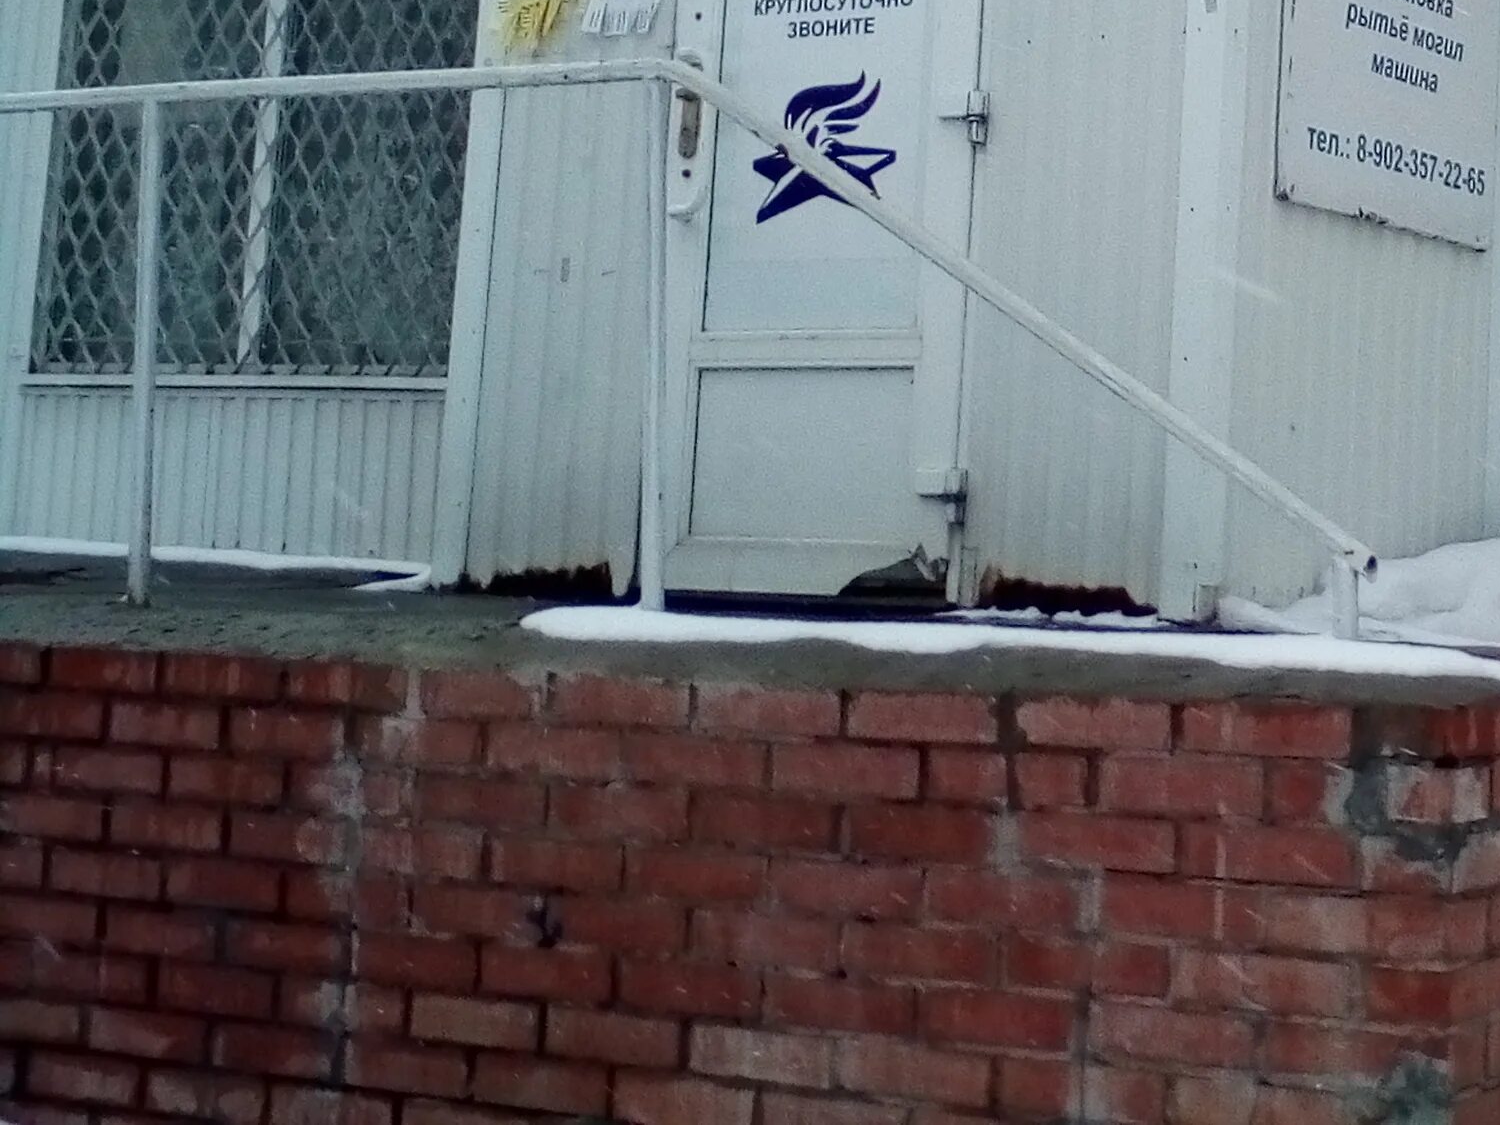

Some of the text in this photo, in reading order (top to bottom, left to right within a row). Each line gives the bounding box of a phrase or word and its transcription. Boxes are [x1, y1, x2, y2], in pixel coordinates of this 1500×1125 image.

[787, 17, 875, 39] ЗВОНИТЕ
[1345, 2, 1464, 62] рытьё могил
[1371, 52, 1439, 93] машина
[1307, 126, 1486, 196] тел.: 8-902-357-22-65
